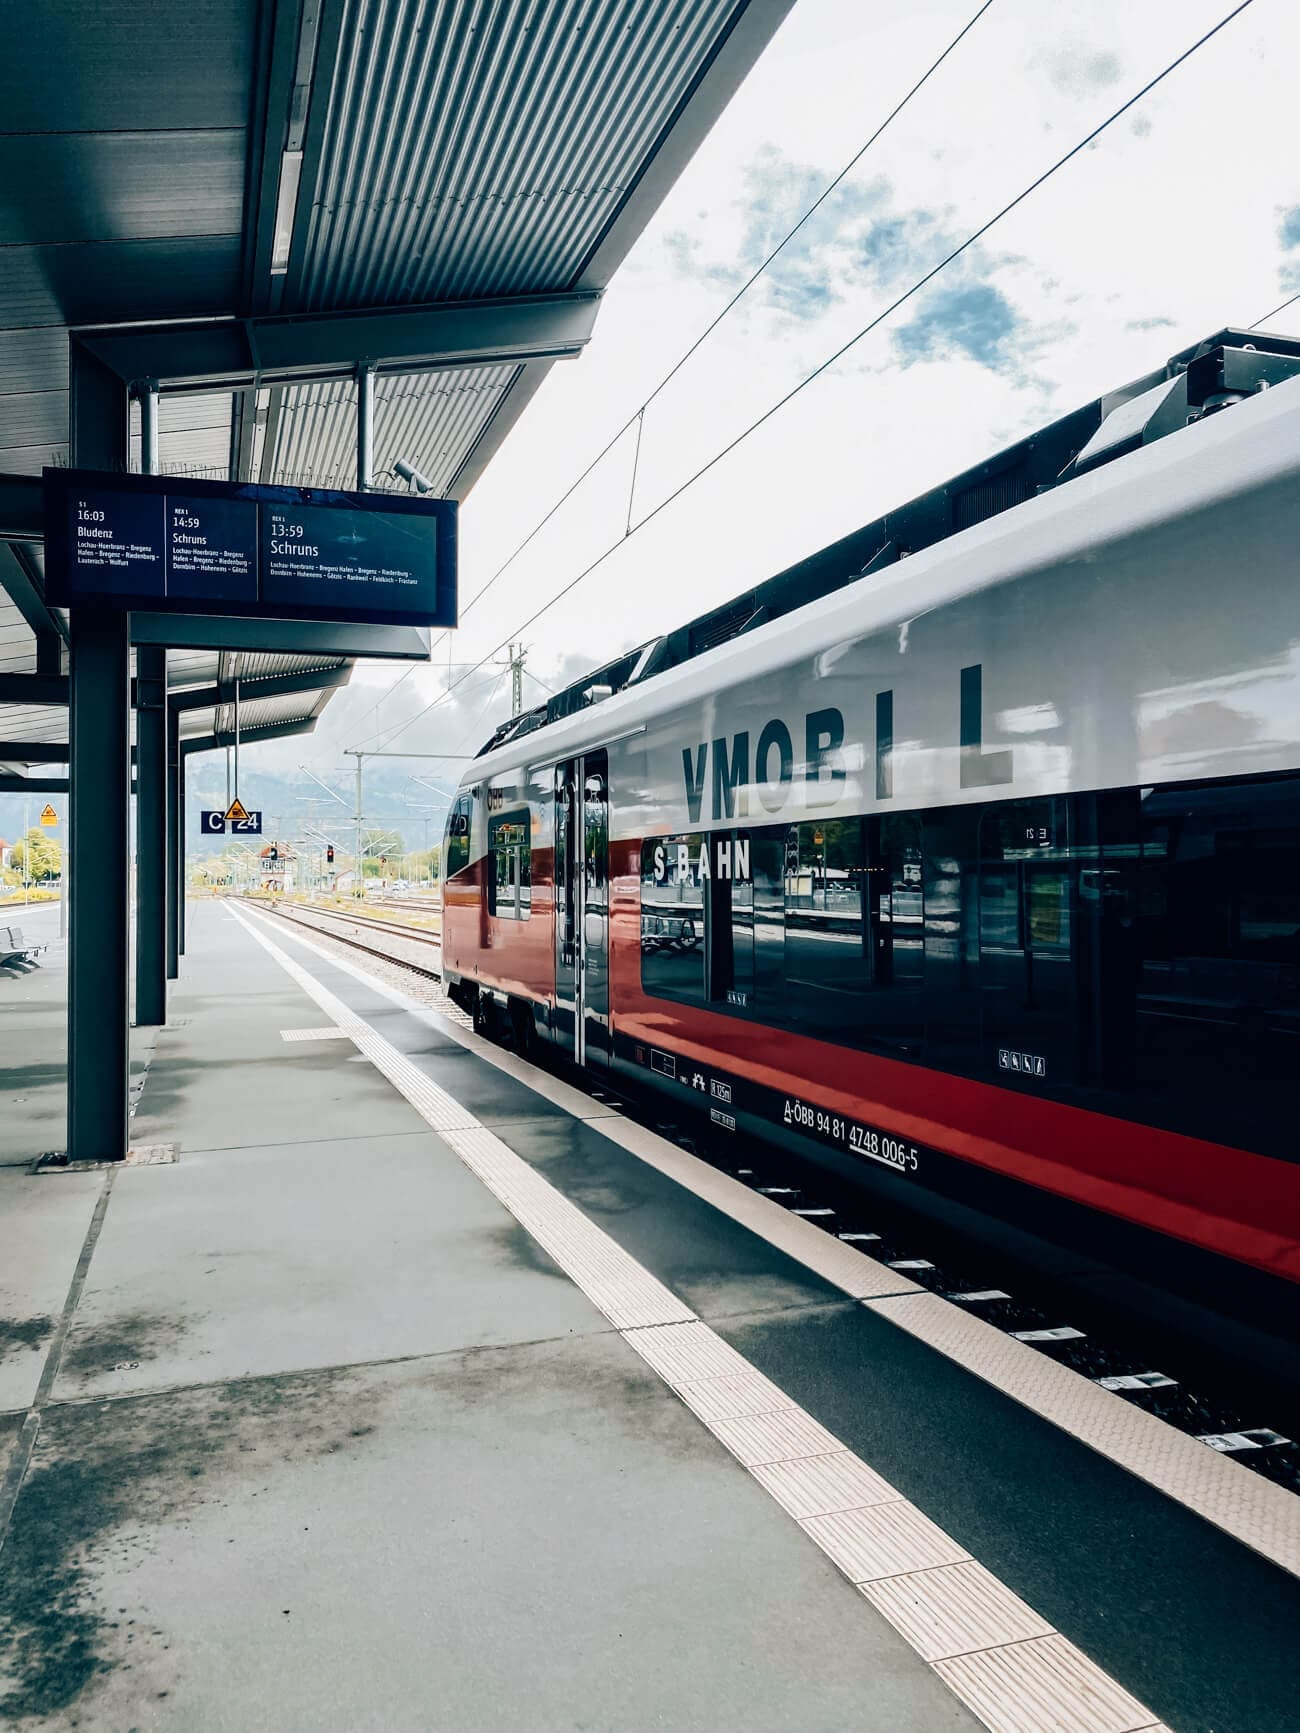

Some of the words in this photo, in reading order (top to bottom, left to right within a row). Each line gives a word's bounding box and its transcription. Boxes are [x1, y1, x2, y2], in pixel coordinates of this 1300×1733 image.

[78, 510, 104, 522] 16:03
[173, 518, 200, 528] 14:59
[78, 526, 112, 538] Bludenz
[272, 524, 303, 537] 13:59
[173, 533, 206, 544] Schruns
[271, 540, 319, 556] Schruns
[209, 813, 222, 829] C
[784, 1100, 815, 1127] A-ÖBB
[817, 1112, 830, 1134] 94
[832, 1120, 846, 1141] 81
[849, 1125, 878, 1154] 4748
[882, 1137, 918, 1170] 006-5
